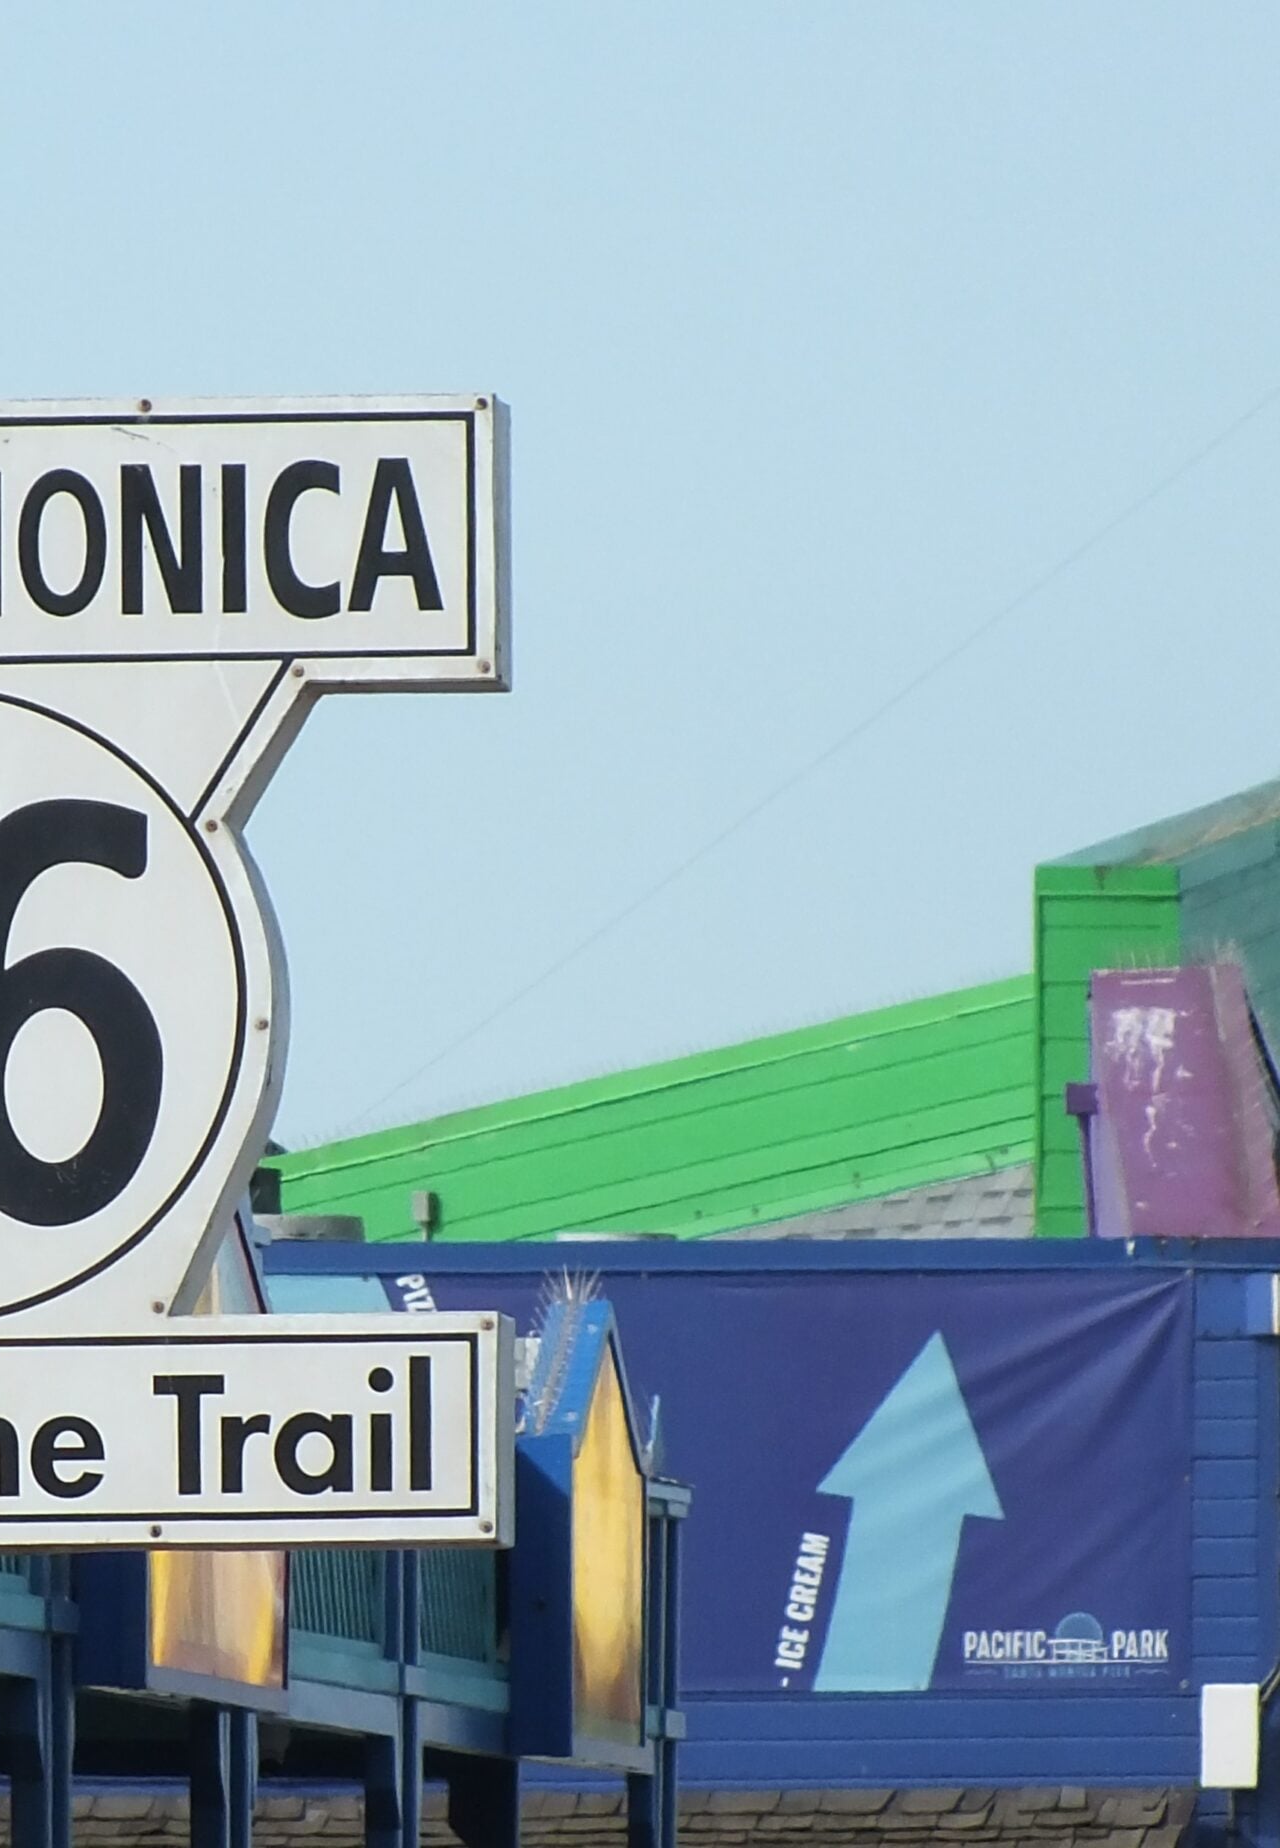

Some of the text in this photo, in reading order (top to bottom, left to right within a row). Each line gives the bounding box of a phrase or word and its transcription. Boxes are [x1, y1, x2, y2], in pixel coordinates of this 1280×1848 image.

[152, 1355, 433, 1495] Trail
[786, 1531, 831, 1622] CREAM
[774, 1625, 810, 1669] ICE
[963, 1629, 1169, 1659] PACIFIC PARK
